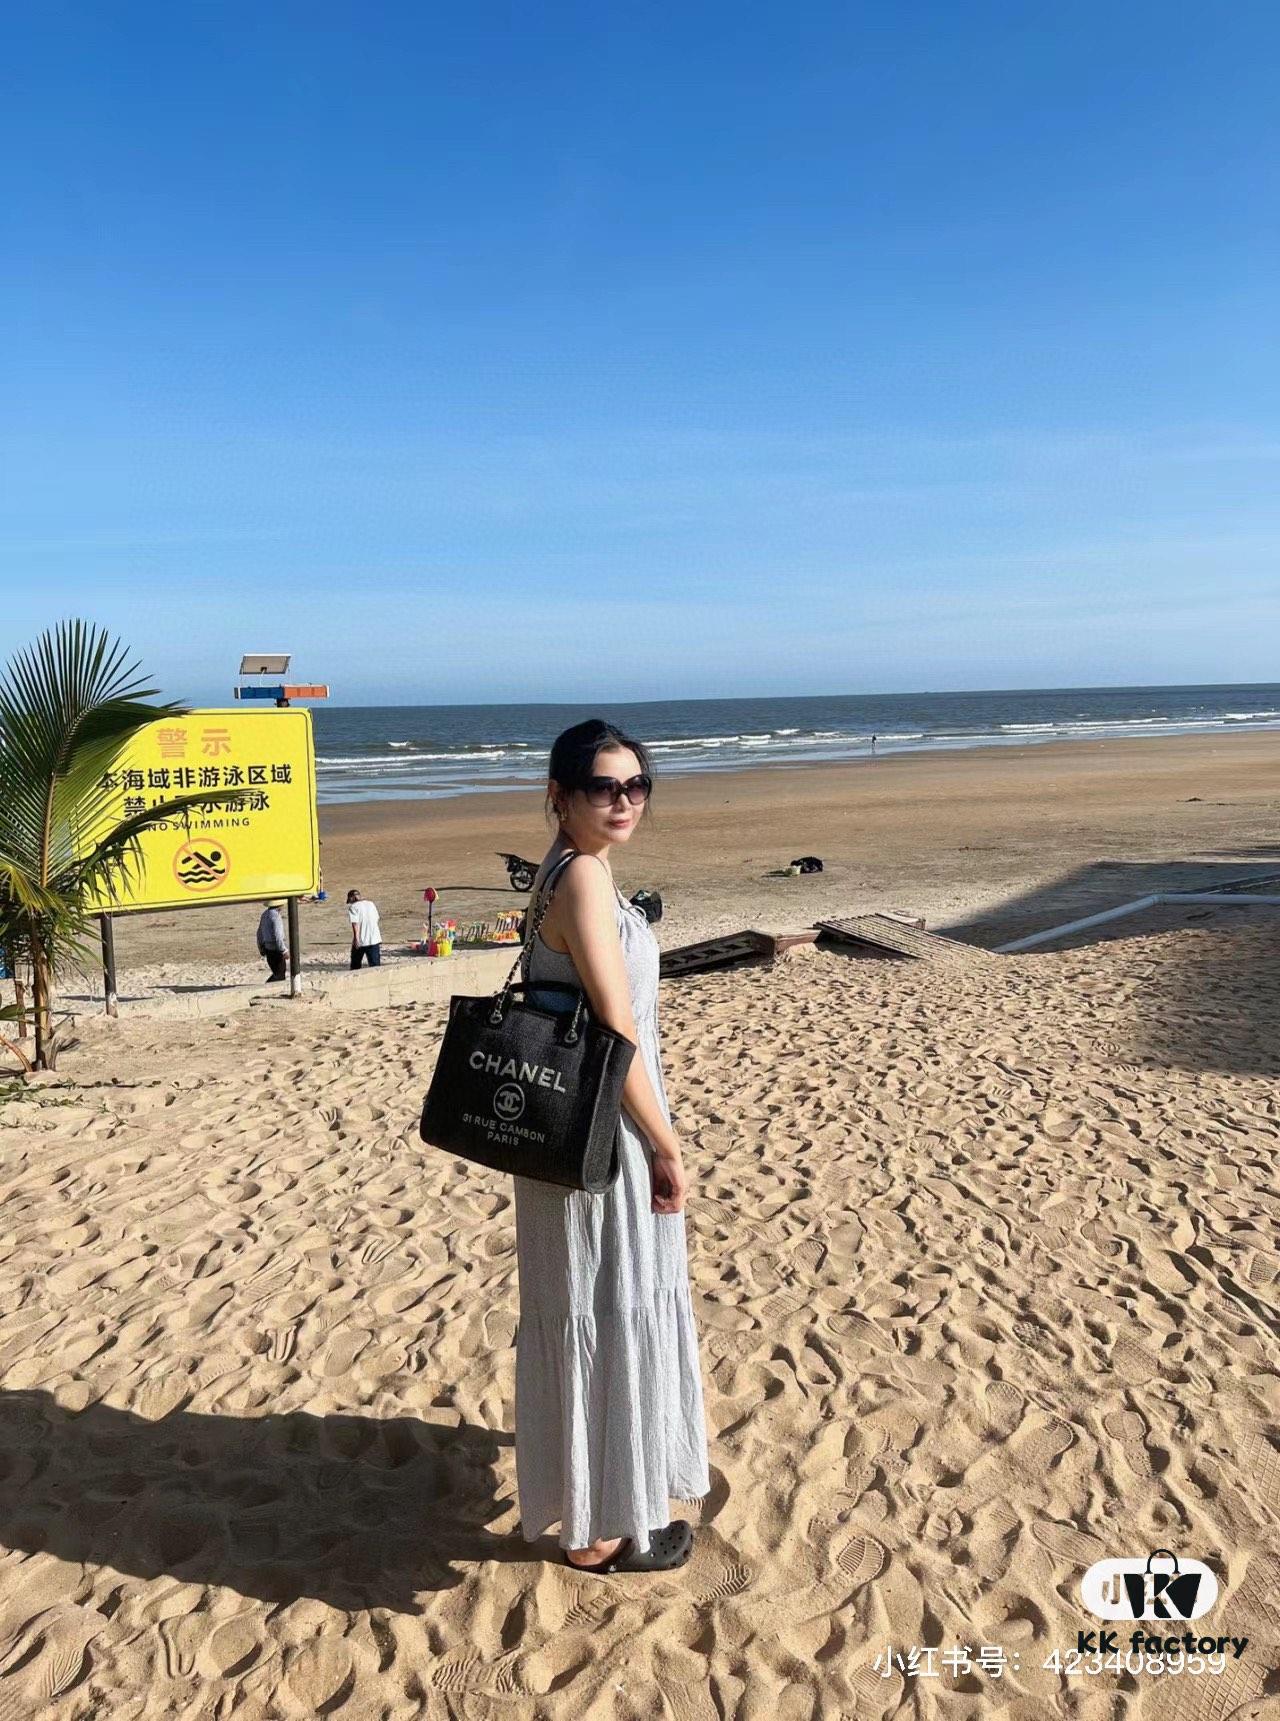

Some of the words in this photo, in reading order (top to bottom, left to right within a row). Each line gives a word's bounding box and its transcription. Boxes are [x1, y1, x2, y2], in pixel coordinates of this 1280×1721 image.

[156, 727, 231, 758] 警示
[173, 817, 250, 831] SWIMMING
[469, 1050, 567, 1094] CHANEL
[474, 1116, 497, 1130] RUE
[499, 1122, 545, 1144] CAMBON
[487, 1131, 519, 1146] PARIS
